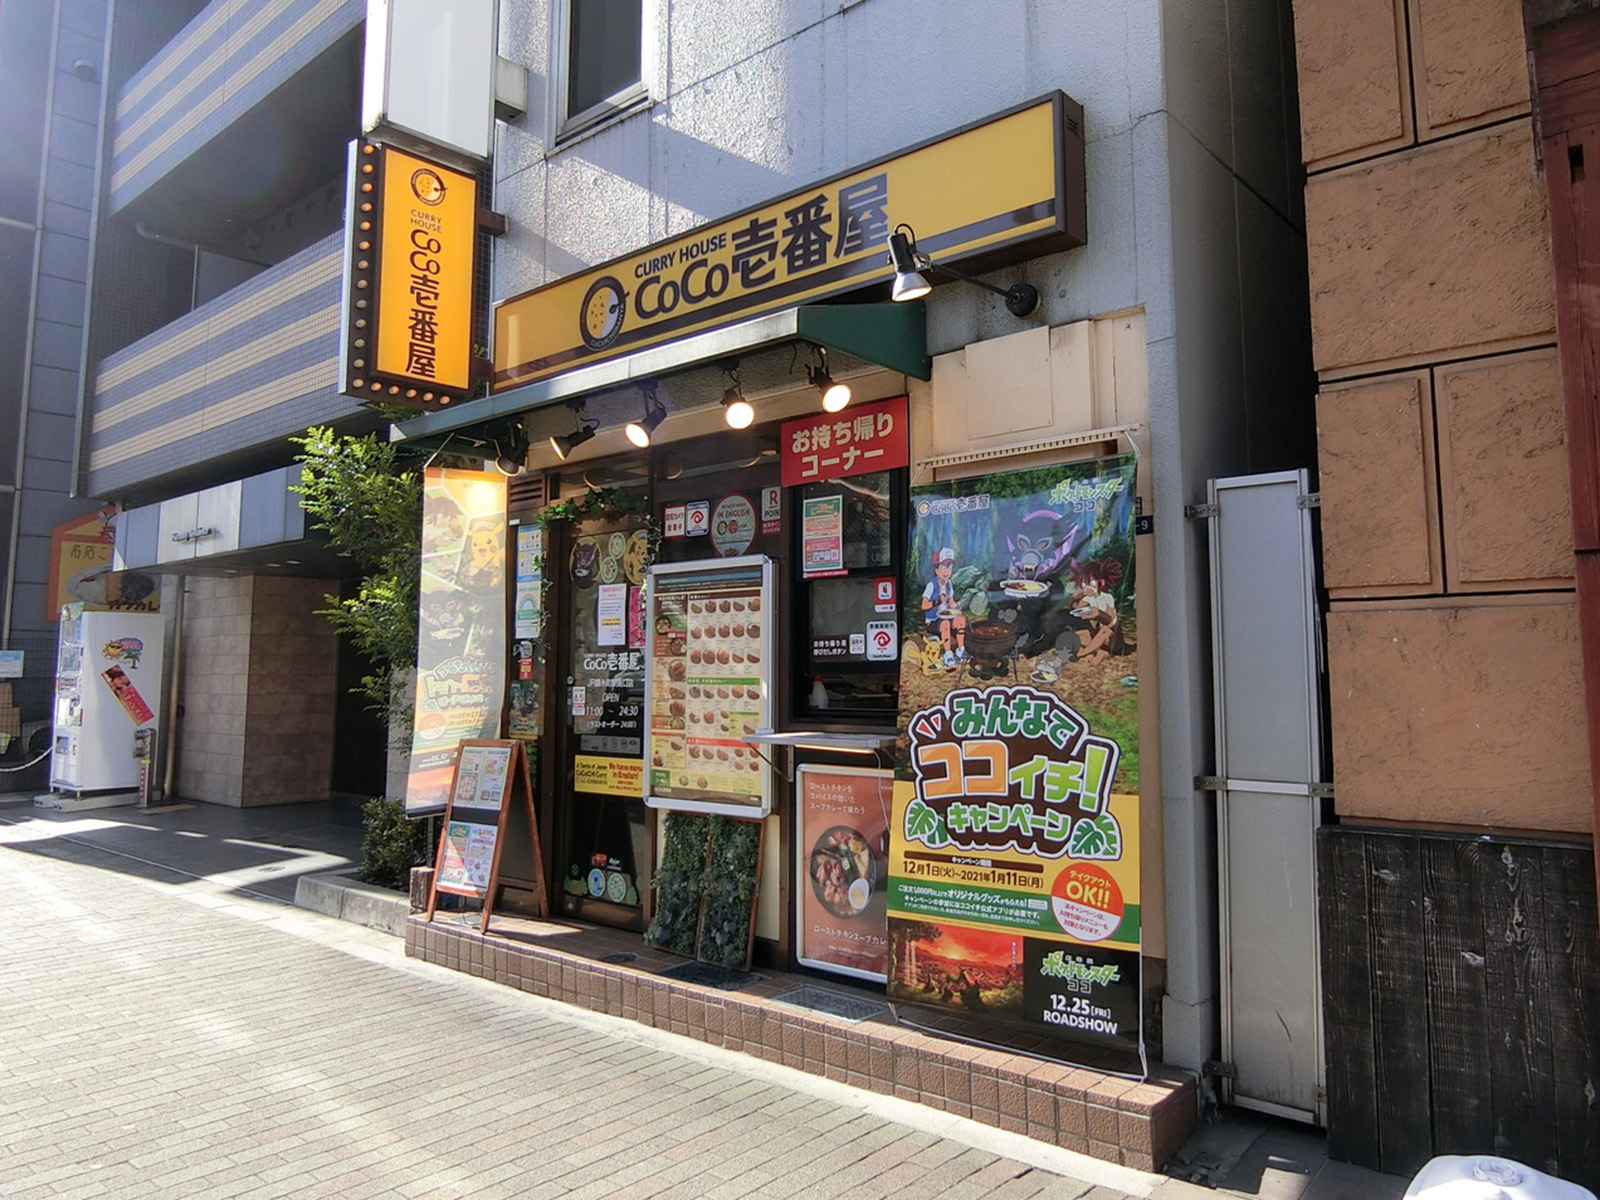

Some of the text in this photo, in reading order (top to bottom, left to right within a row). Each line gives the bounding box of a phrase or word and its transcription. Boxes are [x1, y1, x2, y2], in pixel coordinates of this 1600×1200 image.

[411, 208, 442, 224] CURRY
[411, 217, 442, 233] HOUSE
[634, 231, 727, 279] CURRY HOUSE
[635, 172, 889, 320] CoCo壱番屋
[791, 412, 894, 454] お持ち帰り
[801, 445, 884, 477] コーナー
[764, 509, 780, 517] POIN
[602, 692, 620, 703] OPEN
[952, 694, 1079, 750] みんなで
[917, 739, 1109, 812] ココイチ!
[810, 782, 852, 793] ローストチキンを
[947, 801, 1072, 841] キャンペーン
[1069, 869, 1111, 888] テイクアウト
[1066, 880, 1110, 909] OK!!
[813, 924, 887, 945] ローストチキンスープカレ
[1067, 978, 1092, 994] ココ
[1050, 994, 1091, 1015] 12.25
[1043, 1009, 1118, 1035] ROADSHOW
